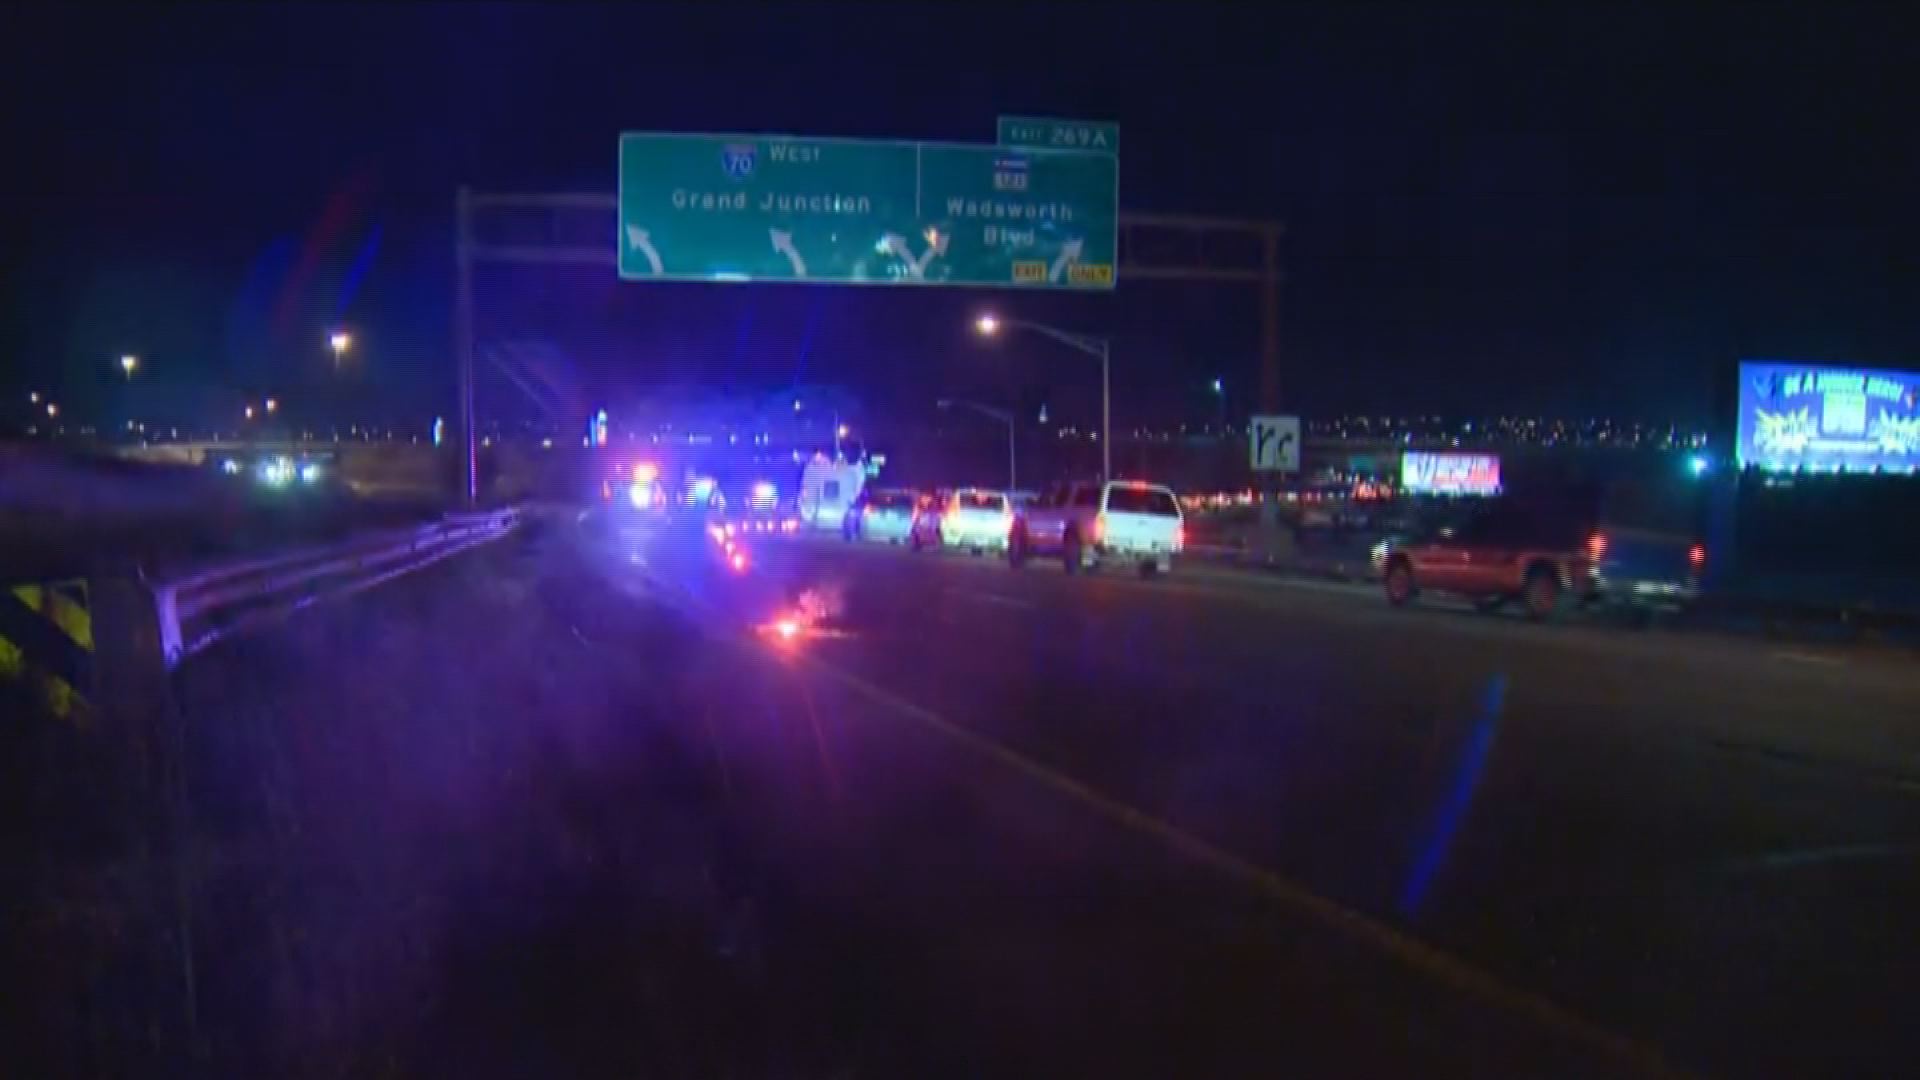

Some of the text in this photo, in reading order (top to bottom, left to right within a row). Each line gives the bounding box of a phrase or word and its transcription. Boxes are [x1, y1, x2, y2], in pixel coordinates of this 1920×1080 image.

[729, 155, 752, 174] 70
[671, 188, 870, 213] Grand Junction
[946, 197, 1073, 222] Wadsworth
[983, 225, 1035, 247] Blvd
